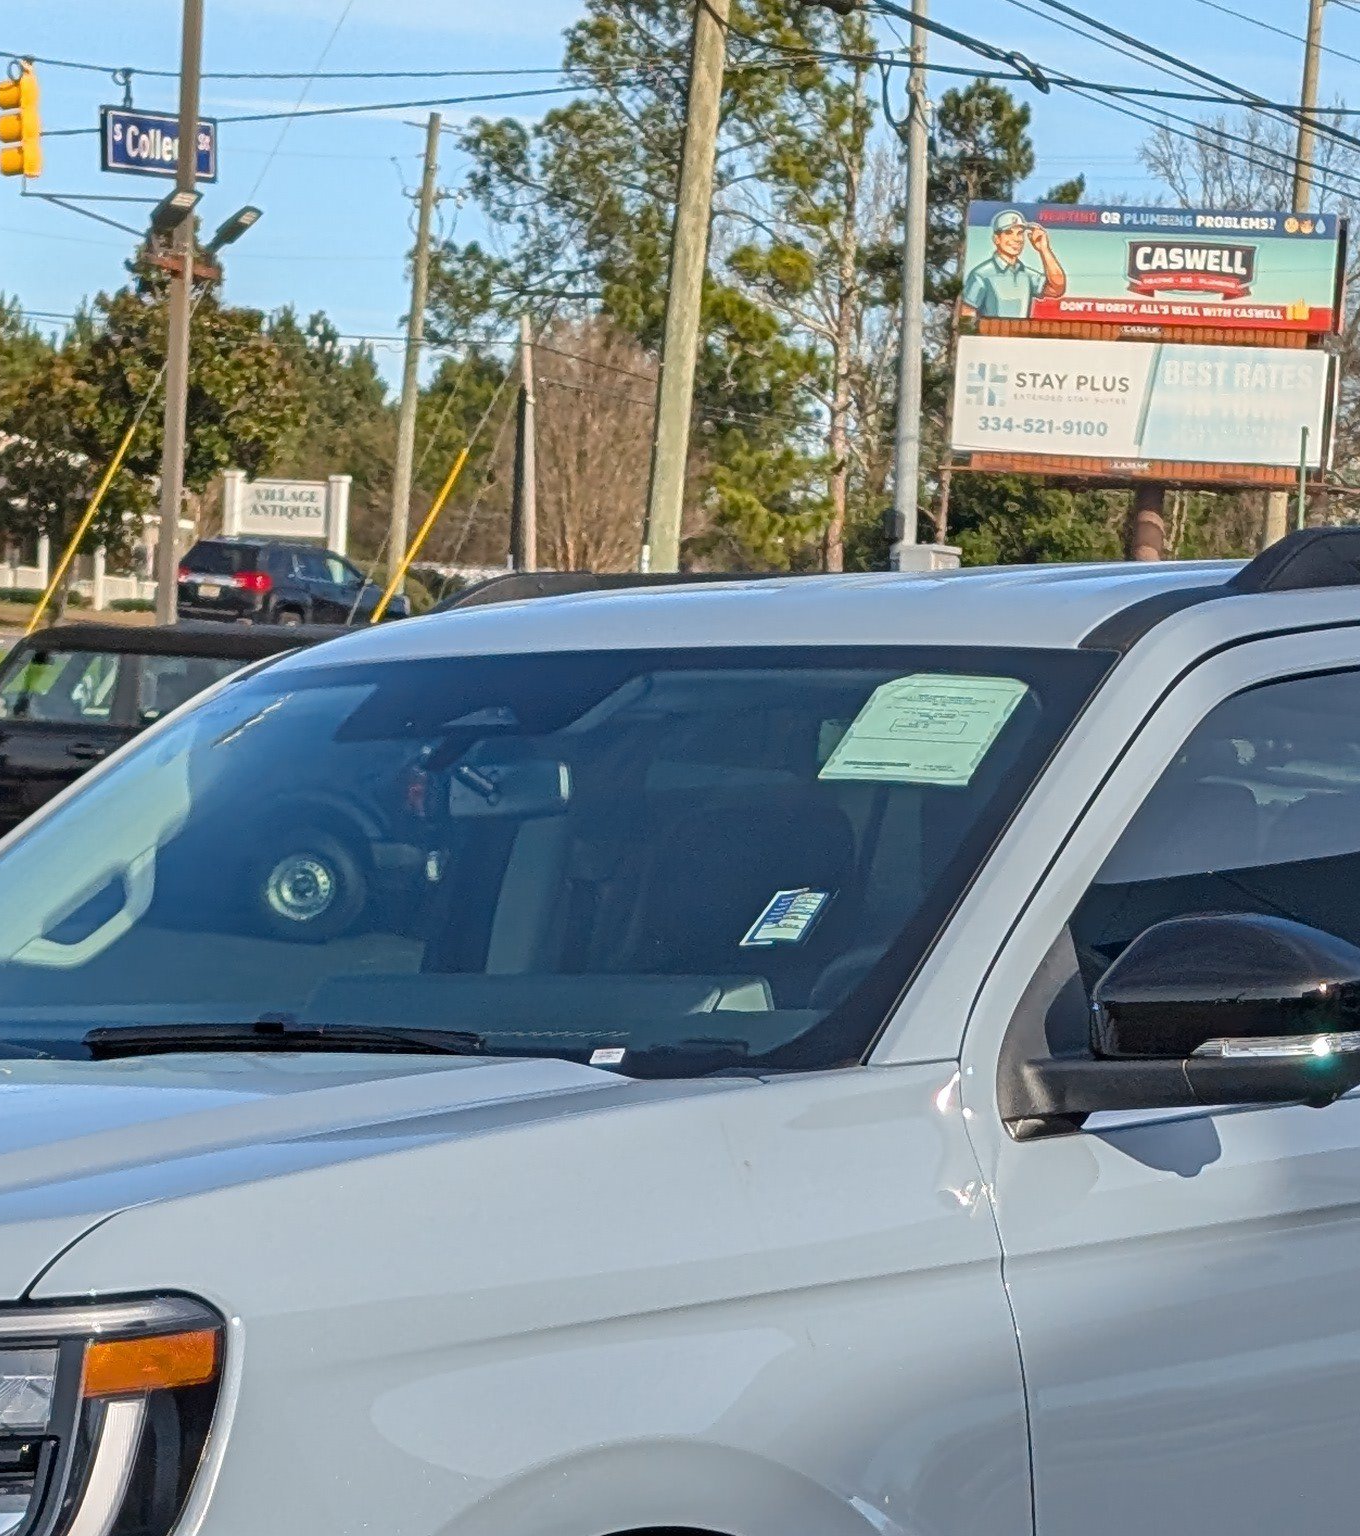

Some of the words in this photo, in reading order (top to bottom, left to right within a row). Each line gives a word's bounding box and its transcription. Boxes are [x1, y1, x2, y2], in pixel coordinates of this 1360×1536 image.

[113, 122, 123, 142] S
[126, 124, 180, 162] Colle
[1100, 211, 1121, 225] OR
[1135, 246, 1248, 276] CASWELL
[1202, 306, 1232, 318] WITH
[1233, 307, 1284, 321] CASWELL
[1015, 372, 1068, 391] STAY
[1076, 374, 1130, 393] PLUS
[1163, 360, 1229, 387] BEST
[1233, 361, 1314, 390] RATES
[977, 416, 1109, 437] 334-521-9100
[255, 487, 318, 503] VILLAGE
[249, 503, 322, 521] ANTIQUES
